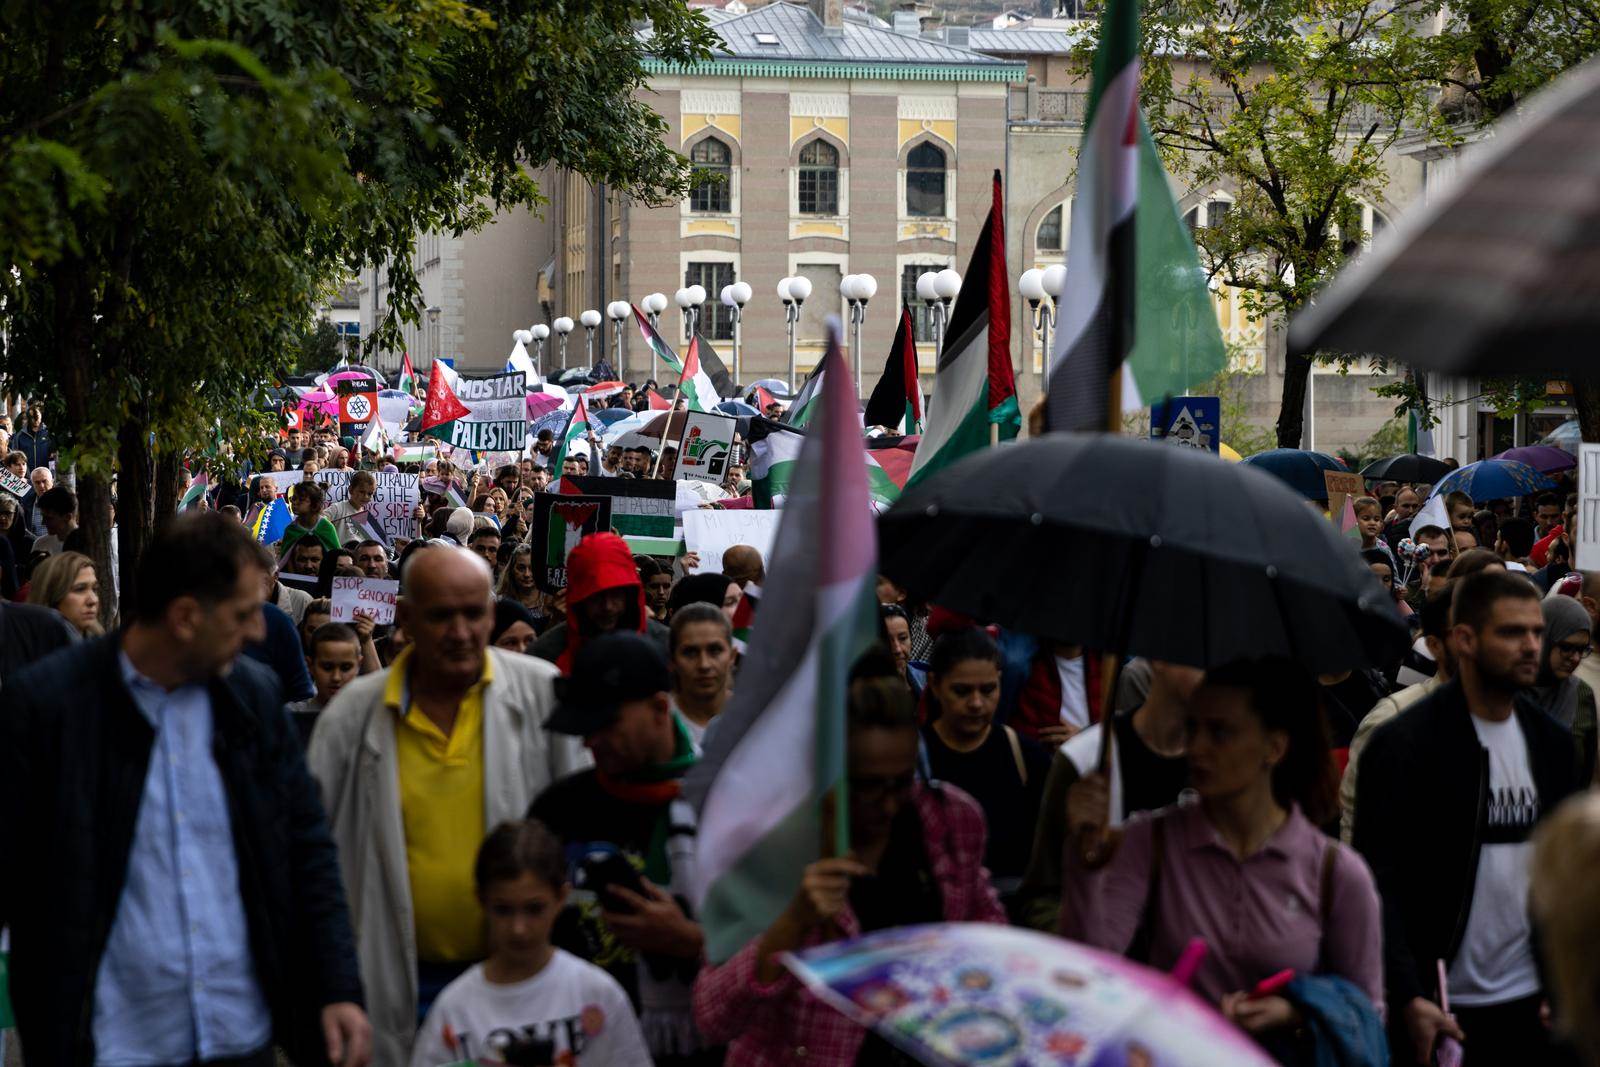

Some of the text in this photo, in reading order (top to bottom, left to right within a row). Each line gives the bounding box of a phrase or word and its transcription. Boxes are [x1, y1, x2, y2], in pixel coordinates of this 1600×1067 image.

[456, 374, 525, 399] MOSTAR
[451, 420, 525, 450] PALESTINU
[313, 471, 354, 487] CHOOSIN
[374, 472, 418, 489] UTRALITY
[387, 488, 413, 503] THE
[386, 502, 410, 518] SIDE
[547, 567, 568, 578] FRE
[334, 577, 364, 591] STOP
[332, 606, 343, 618] IN
[352, 606, 381, 621] GAZA
